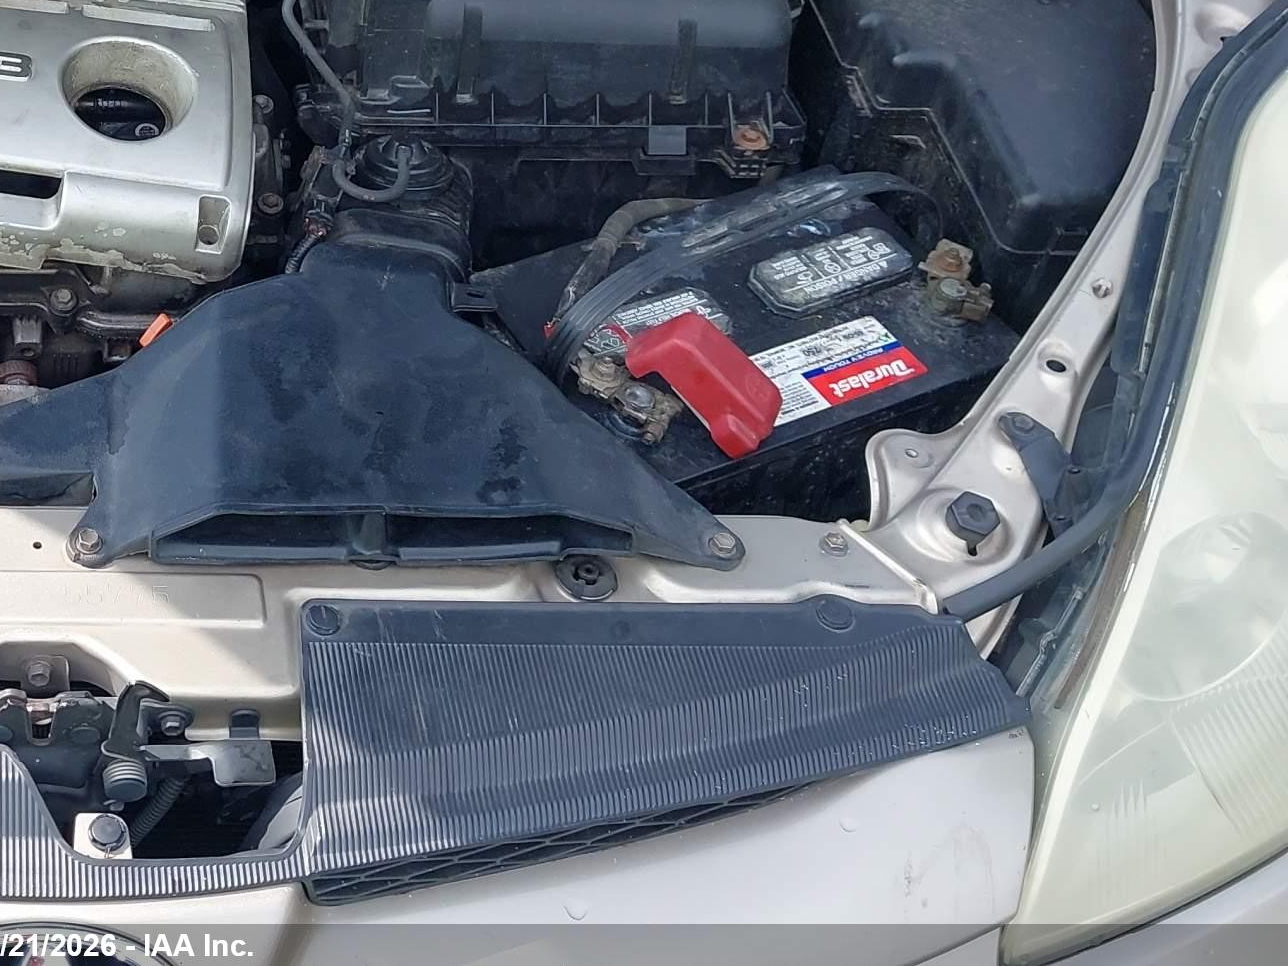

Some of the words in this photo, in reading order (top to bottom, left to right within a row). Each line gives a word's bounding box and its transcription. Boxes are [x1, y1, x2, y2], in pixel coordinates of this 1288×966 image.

[803, 278, 837, 294] POISON
[823, 357, 852, 373] TOUGH
[828, 359, 916, 398] Duralast
